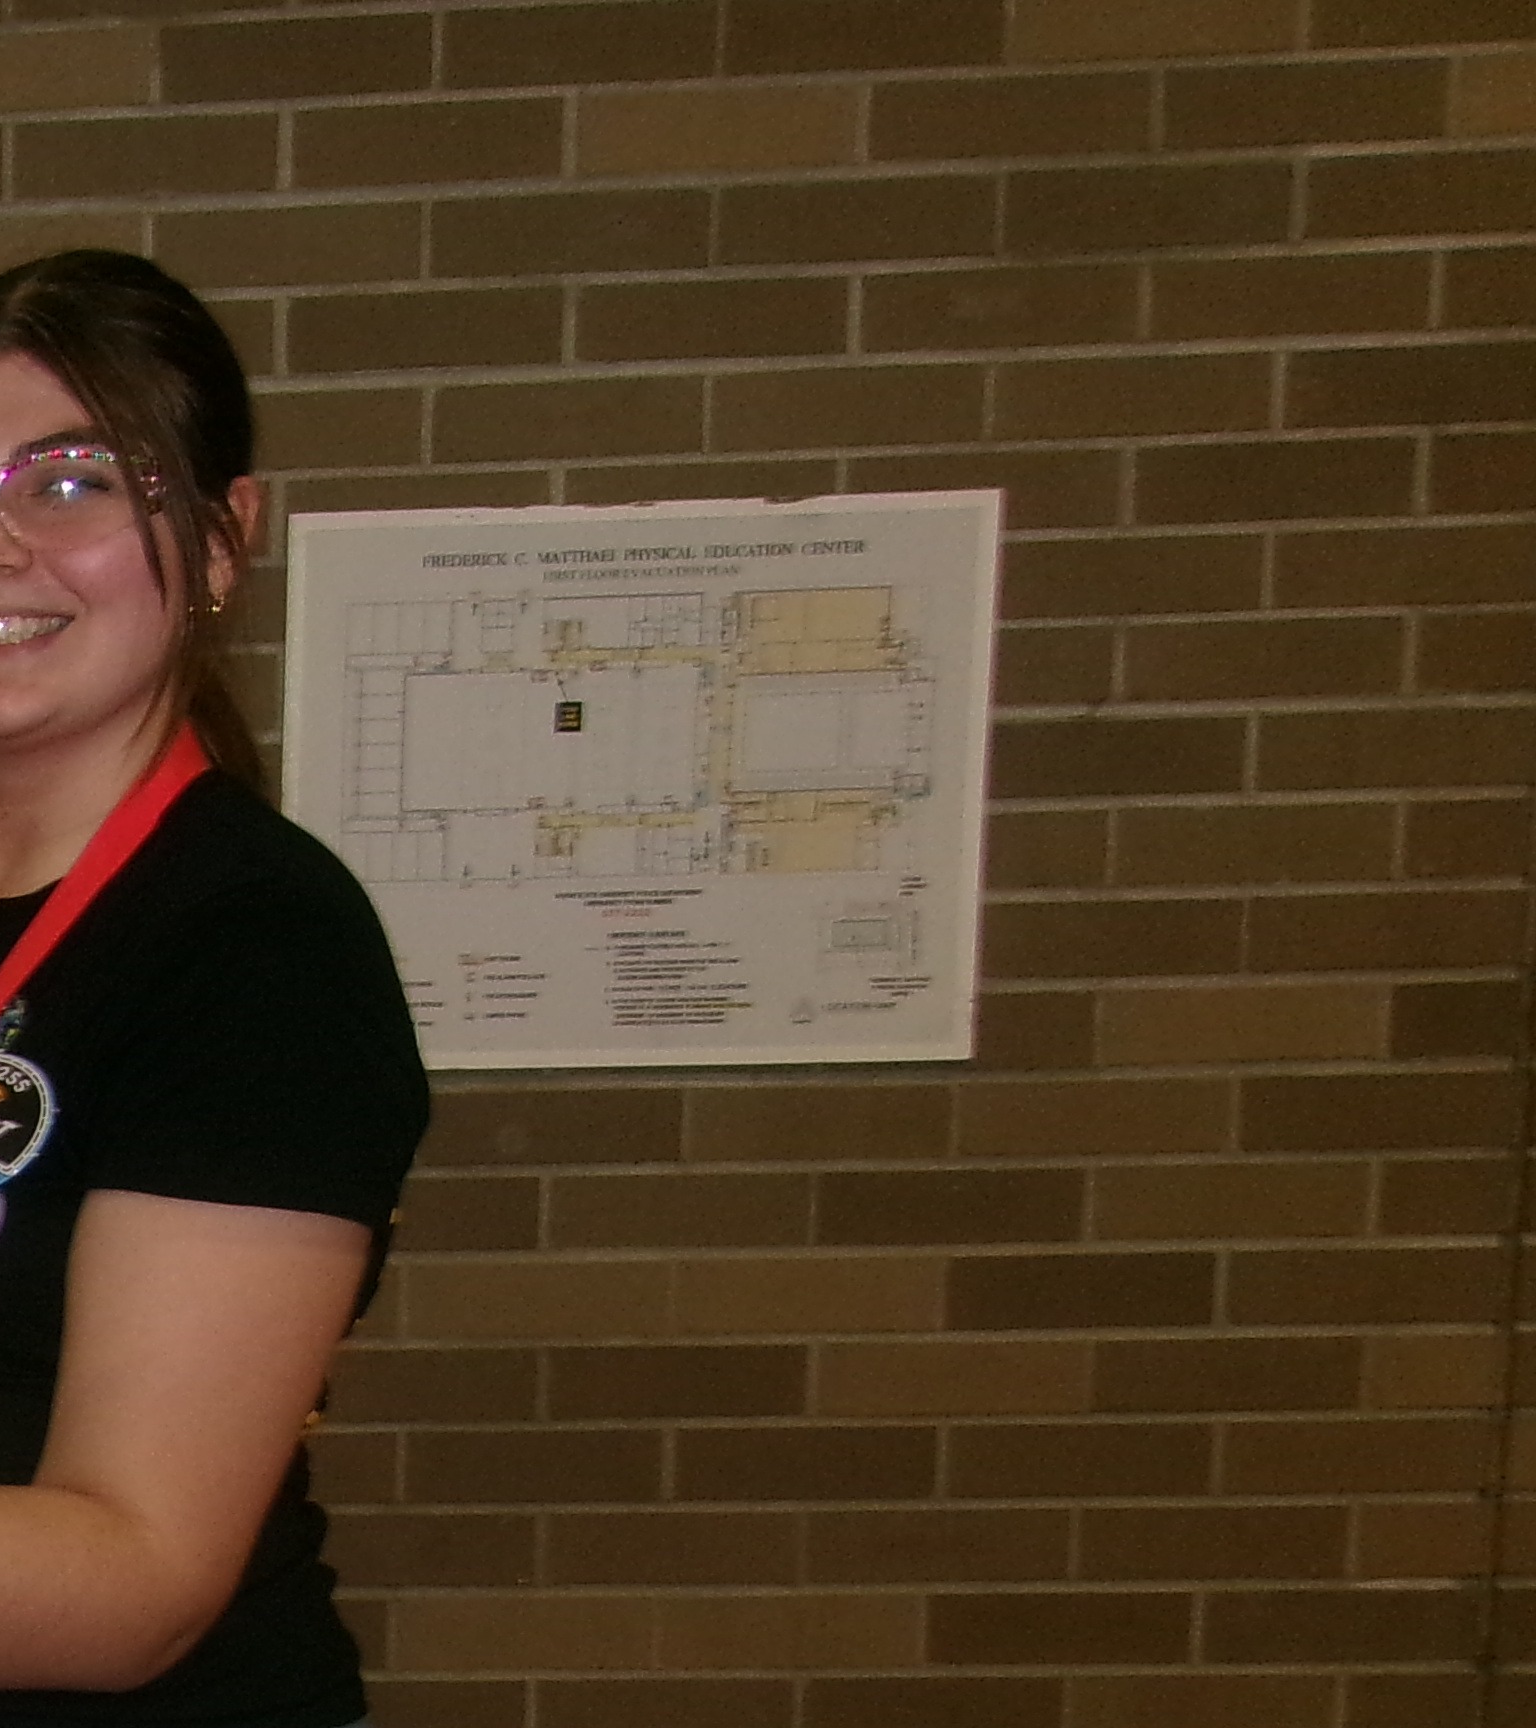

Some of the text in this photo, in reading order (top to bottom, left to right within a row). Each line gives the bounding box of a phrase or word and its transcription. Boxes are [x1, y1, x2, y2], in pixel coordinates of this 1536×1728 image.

[422, 553, 508, 568] FREDERICK
[537, 548, 615, 565] MATTHAEI
[624, 547, 696, 562] PHYSICAL
[705, 543, 793, 559] EDUCATION
[801, 538, 866, 556] CENTER
